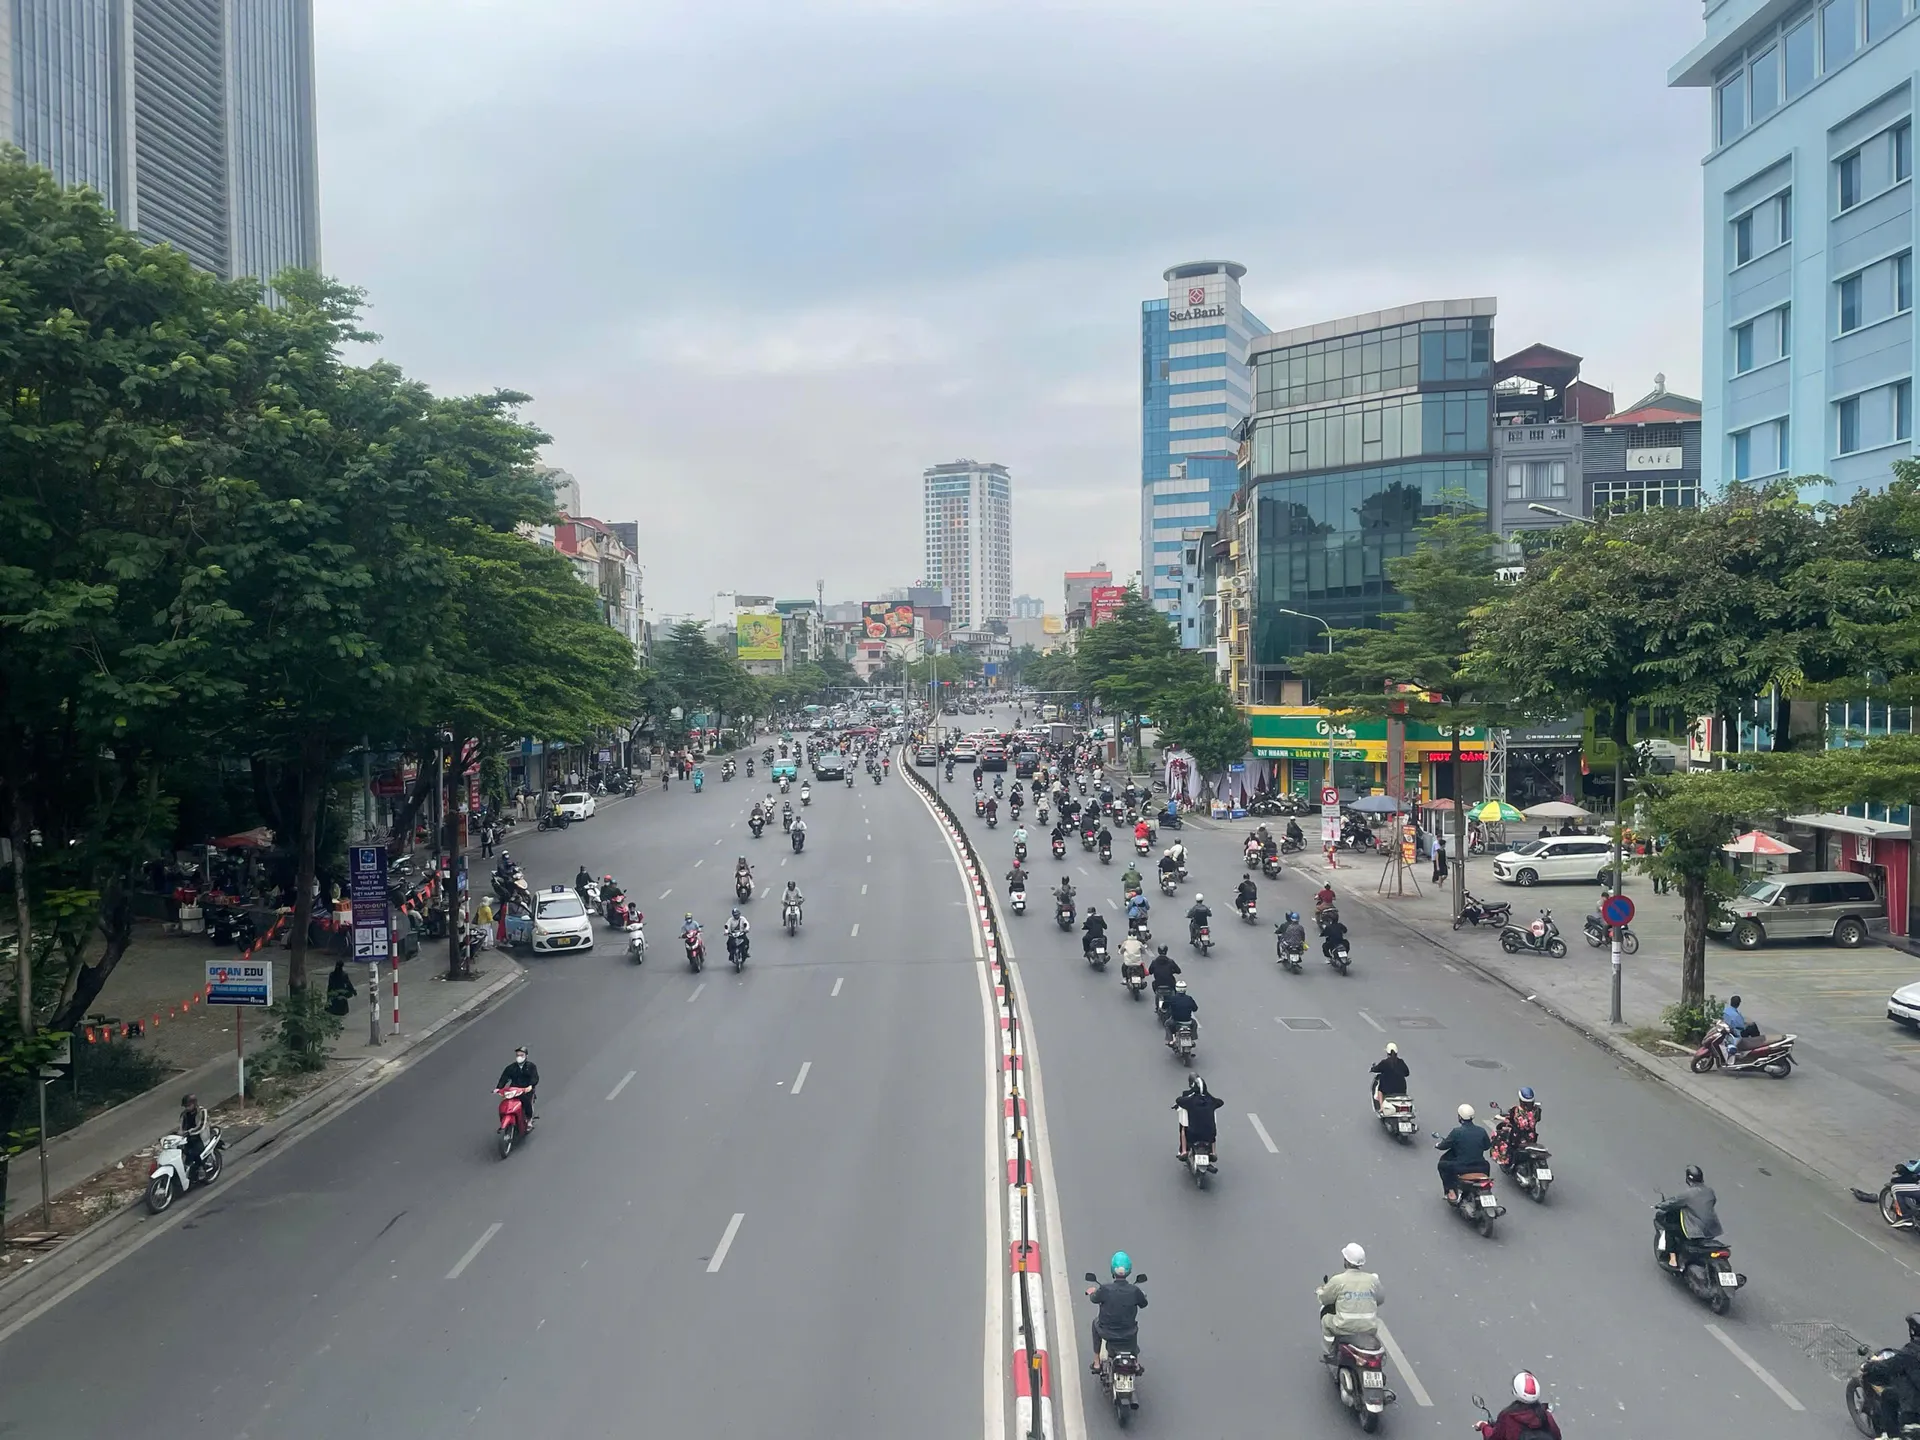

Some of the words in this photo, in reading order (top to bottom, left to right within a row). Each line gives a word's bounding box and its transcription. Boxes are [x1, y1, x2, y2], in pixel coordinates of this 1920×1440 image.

[1169, 304, 1225, 322] SeABank
[1637, 452, 1671, 465] CAFÉ
[1460, 751, 1489, 761] OÀNG
[244, 967, 264, 977] EDU
